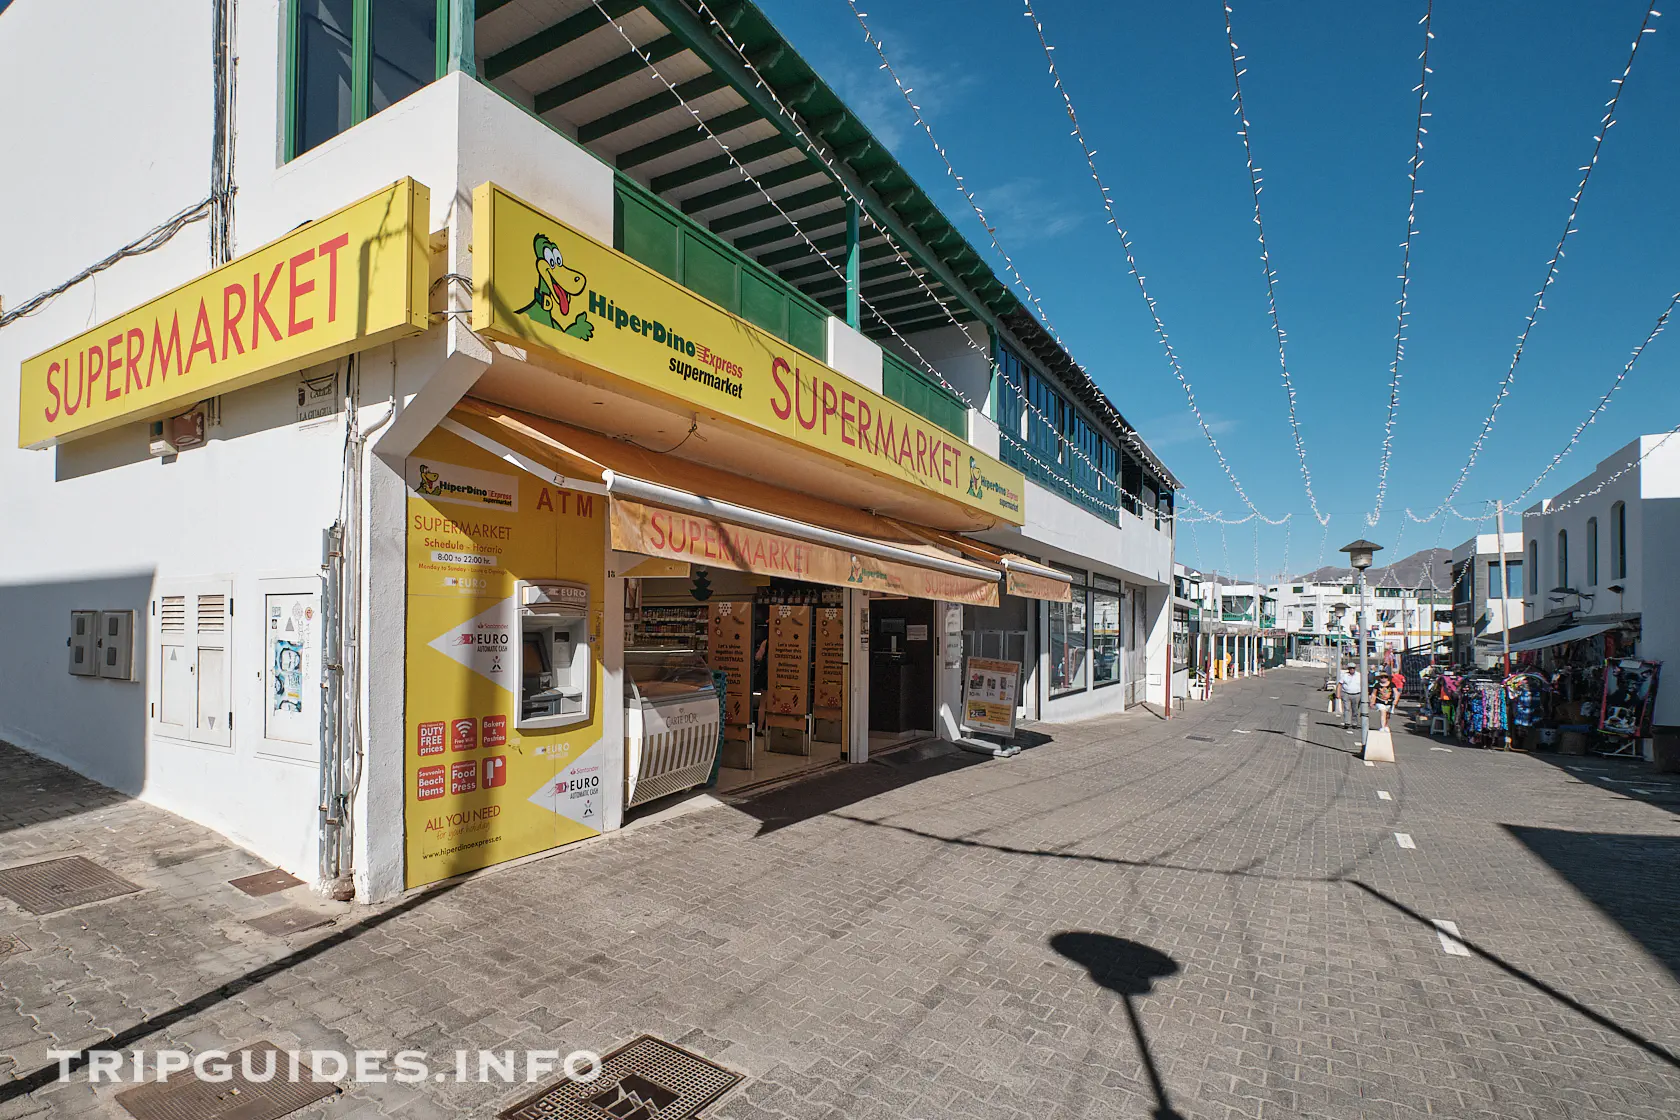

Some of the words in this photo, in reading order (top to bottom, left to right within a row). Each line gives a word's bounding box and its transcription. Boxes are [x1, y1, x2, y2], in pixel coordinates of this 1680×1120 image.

[44, 232, 349, 423] SUPERMARKET
[588, 289, 696, 357] HiperDino
[698, 345, 744, 379] Express
[668, 357, 743, 399] supermarket
[310, 386, 332, 399] CALLE
[770, 356, 962, 489] SUPERMARKET
[439, 480, 488, 497] HiperDino
[489, 490, 512, 500] Express
[482, 497, 512, 507] supermarket
[536, 487, 593, 519] ATM
[414, 515, 512, 541] SUPERMARKET
[424, 537, 464, 551] Schedule
[473, 543, 503, 555] Horario
[650, 511, 814, 575] SUPERMARKET
[437, 552, 454, 562] 8:00
[463, 555, 482, 564] 22:00
[418, 562, 440, 571] Monday
[447, 565, 466, 573] Sunday
[458, 578, 487, 589] EURO
[561, 588, 587, 598] EURO
[477, 633, 509, 645] EURO
[420, 726, 444, 737] DUTY
[483, 721, 505, 729] Bakery
[420, 735, 443, 747] FREE
[483, 734, 505, 743] Pastries
[420, 745, 444, 756] prices
[546, 742, 570, 755] EURO
[419, 768, 445, 777] Souvenirs
[452, 766, 476, 779] Food
[576, 766, 599, 775] Santander
[419, 775, 444, 788] Beach
[452, 782, 476, 793] Press
[570, 776, 600, 791] EURO
[418, 786, 444, 798] Items
[424, 817, 444, 833] ALL
[445, 810, 471, 827] YOU
[472, 805, 501, 822] NEED
[422, 835, 502, 860] www.hiperdinoexpress.es
